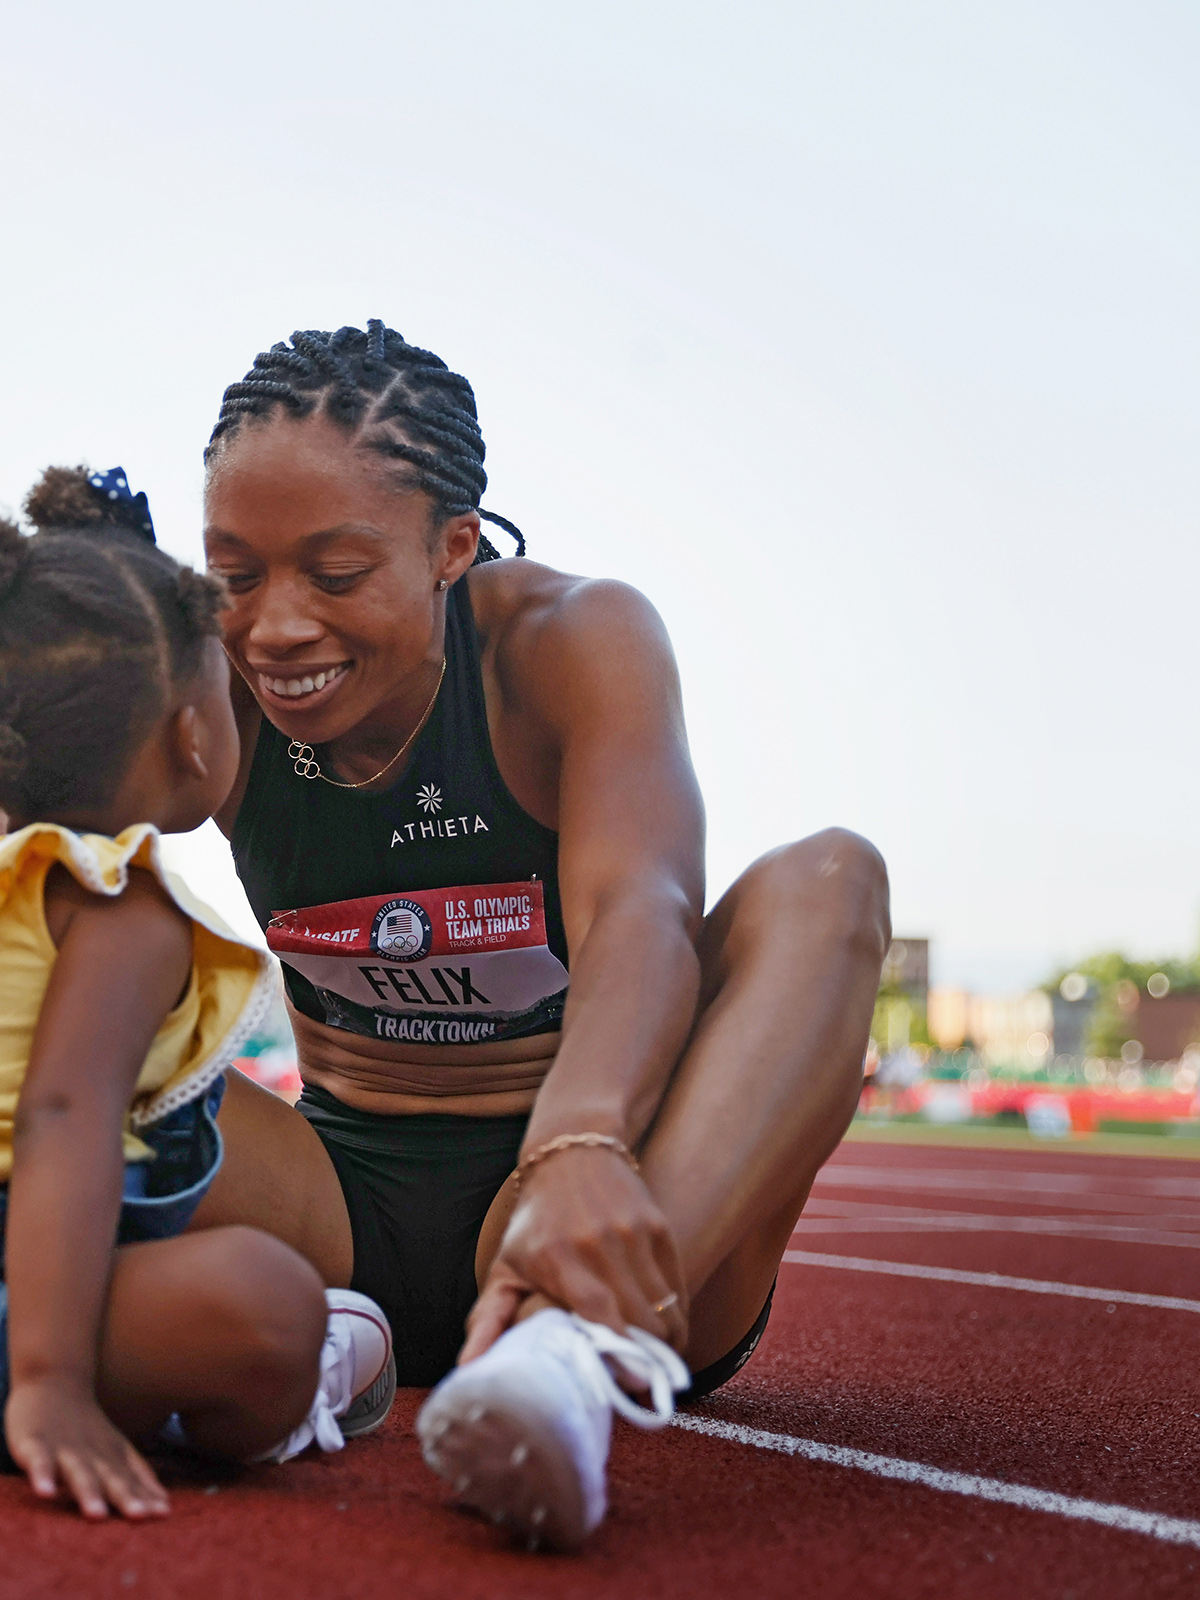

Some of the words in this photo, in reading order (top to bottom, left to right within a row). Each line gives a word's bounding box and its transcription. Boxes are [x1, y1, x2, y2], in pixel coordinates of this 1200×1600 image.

[390, 814, 489, 848] ATHLETA
[375, 900, 397, 922] UNITED
[400, 900, 425, 917] STATES
[445, 900, 470, 919] U.S.
[473, 895, 530, 917] OLYMPIC
[445, 919, 482, 940] TEAM
[485, 915, 530, 935] TRIALS
[449, 939, 476, 948] TRACK
[477, 937, 483, 945] &
[484, 934, 506, 944] FIELD
[357, 966, 492, 1005] FELIX
[374, 1013, 495, 1043] TRACKTOWN
